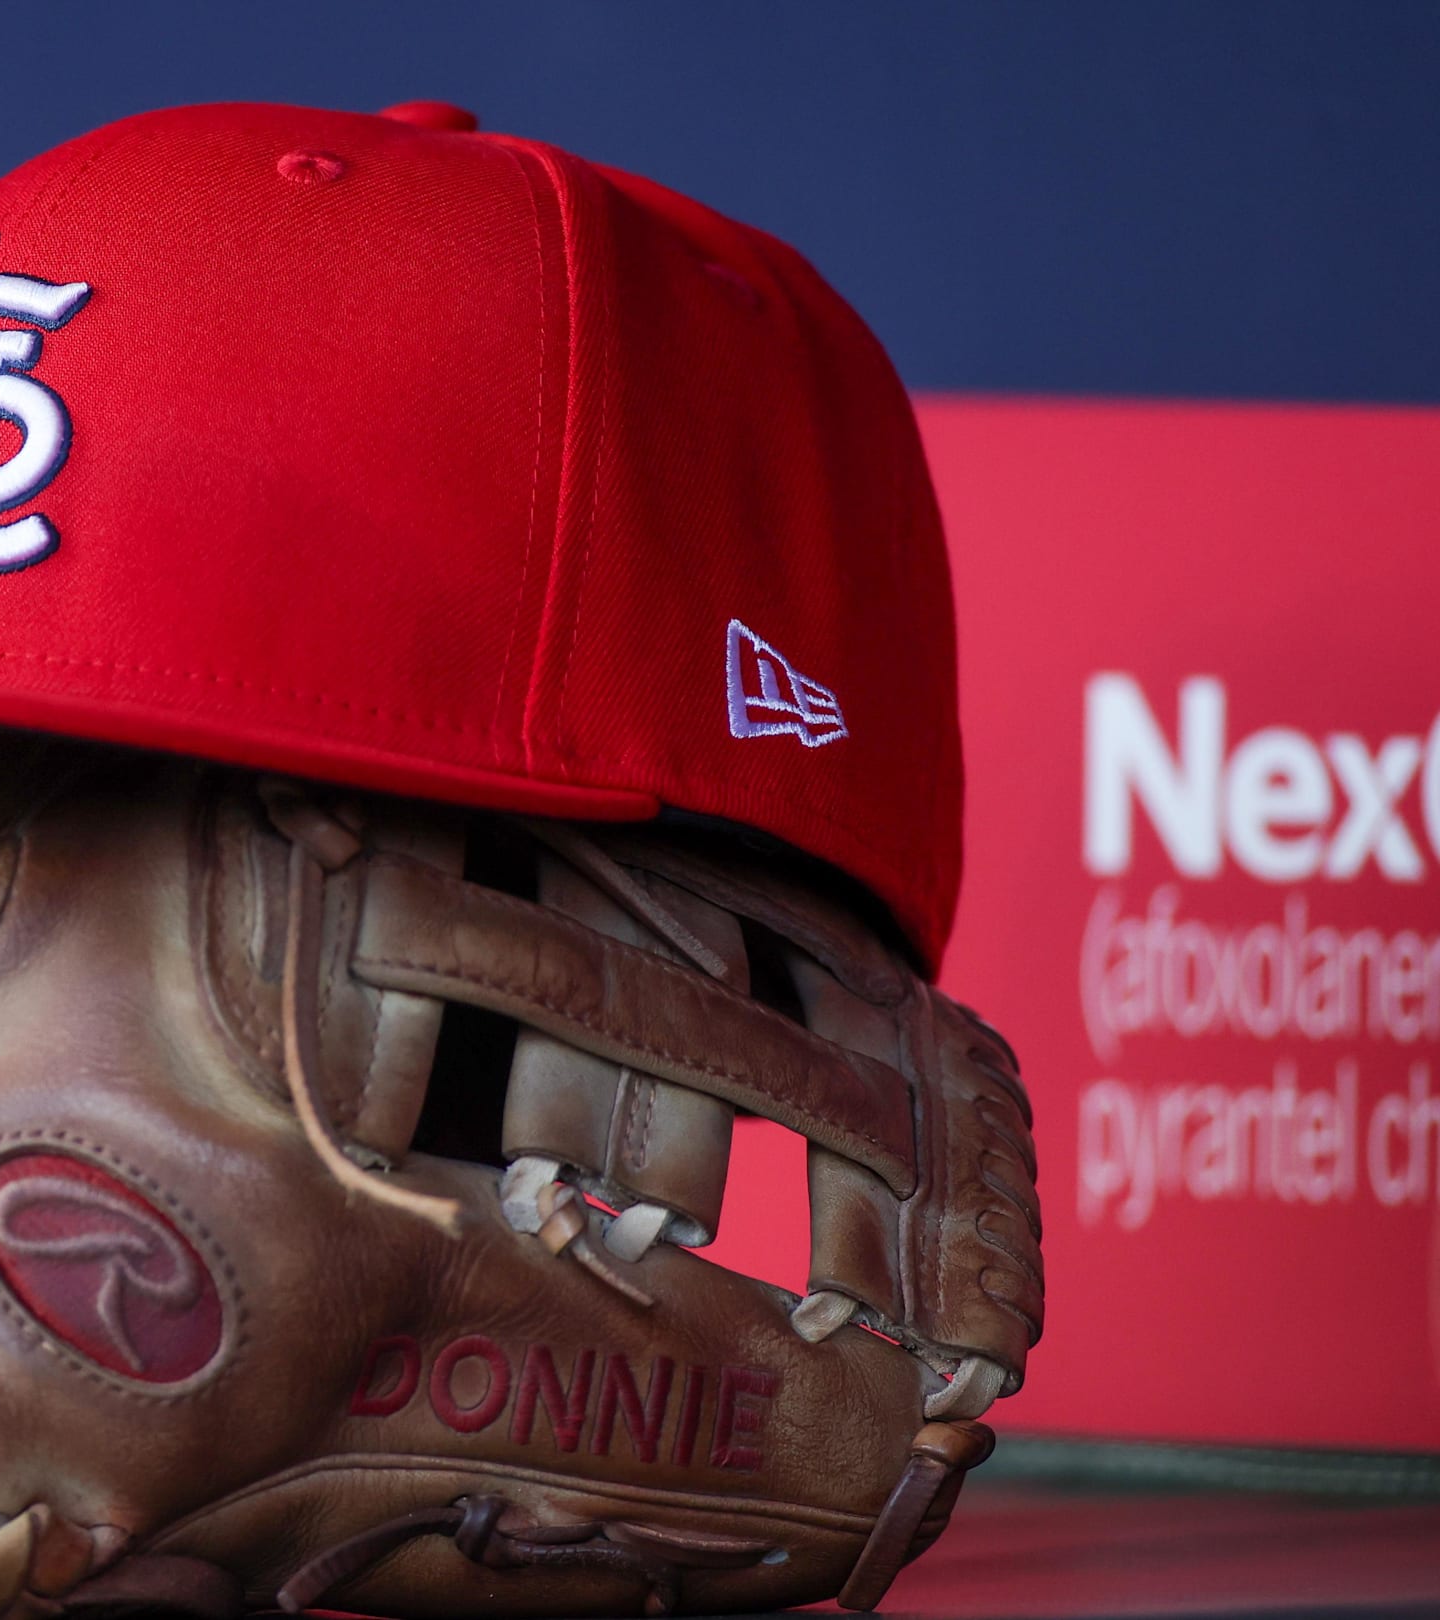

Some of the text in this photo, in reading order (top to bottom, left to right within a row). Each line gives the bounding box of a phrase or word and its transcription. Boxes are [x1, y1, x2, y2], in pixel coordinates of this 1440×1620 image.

[1083, 672, 1440, 881] Nex
[1077, 1059, 1357, 1230] pyrantel
[349, 1334, 782, 1472] DONNIE
